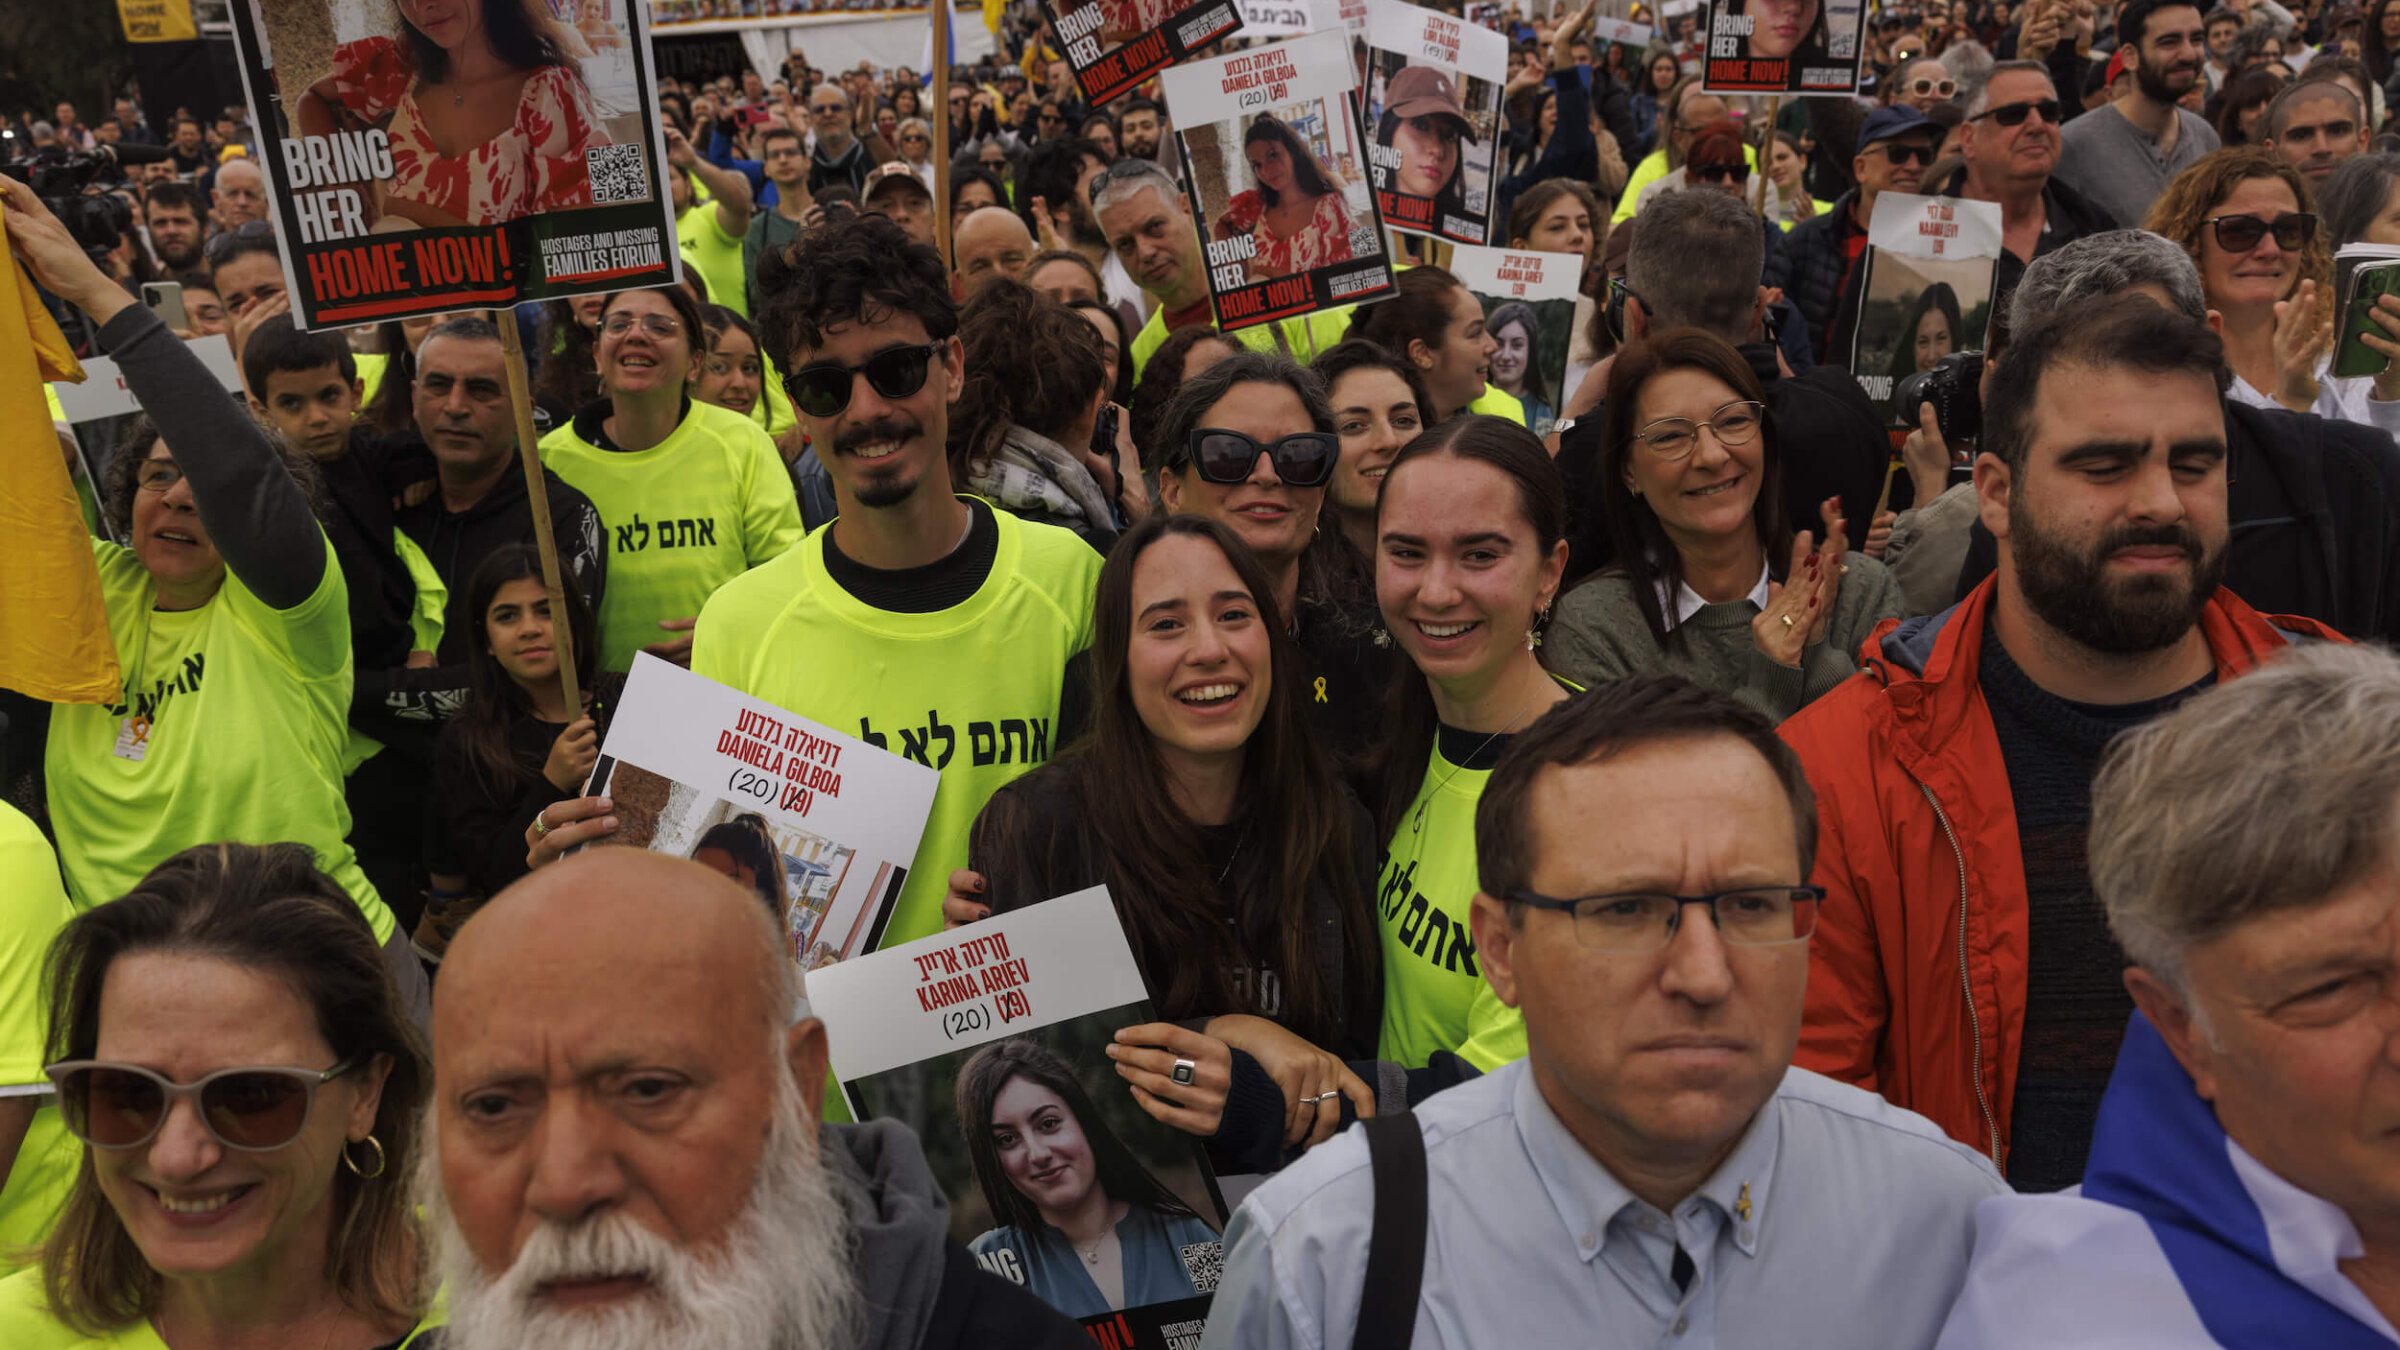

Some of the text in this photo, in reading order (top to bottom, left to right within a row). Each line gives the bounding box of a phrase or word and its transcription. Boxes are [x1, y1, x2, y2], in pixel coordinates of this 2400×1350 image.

[1055, 1, 1105, 46] BRING
[1712, 14, 1755, 37] BRING
[1067, 36, 1103, 70] HER
[1081, 28, 1170, 97] HOME NOW!
[1710, 36, 1739, 58] HER
[1221, 63, 1298, 95] DANIELA GILBOA
[1708, 59, 1747, 81] HOME
[1749, 58, 1789, 82] NOW!
[1239, 90, 1267, 109] (20)
[280, 129, 394, 189] BRING
[293, 188, 370, 244] HER
[1396, 195, 1434, 223] NOW!
[540, 233, 593, 255] HOSTAGES
[593, 231, 615, 249] AND
[614, 226, 660, 246] MISSING
[543, 249, 610, 278] FAMILIES
[611, 242, 664, 271] FORUM
[1206, 233, 1257, 268] BRING
[306, 226, 514, 302] HOME NOW!
[1212, 262, 1247, 293] HER
[1218, 272, 1315, 321] HOME NOW!
[1330, 280, 1363, 297] FAMILIES
[615, 513, 717, 553] אתם לא
[735, 708, 784, 747] גלבוע
[897, 709, 956, 771] לא
[968, 718, 1049, 767] אתם
[716, 729, 842, 799] DANIELA GILBOA
[783, 726, 842, 769] דניאלה
[728, 767, 779, 805] (20)
[779, 782, 814, 819] (19)
[1380, 860, 1480, 978] אתם לא
[913, 932, 1011, 982] קרינה ארייב
[915, 957, 1031, 1013] KARINA ARIEV
[943, 1002, 991, 1041] (20)
[993, 987, 1032, 1024] (19)
